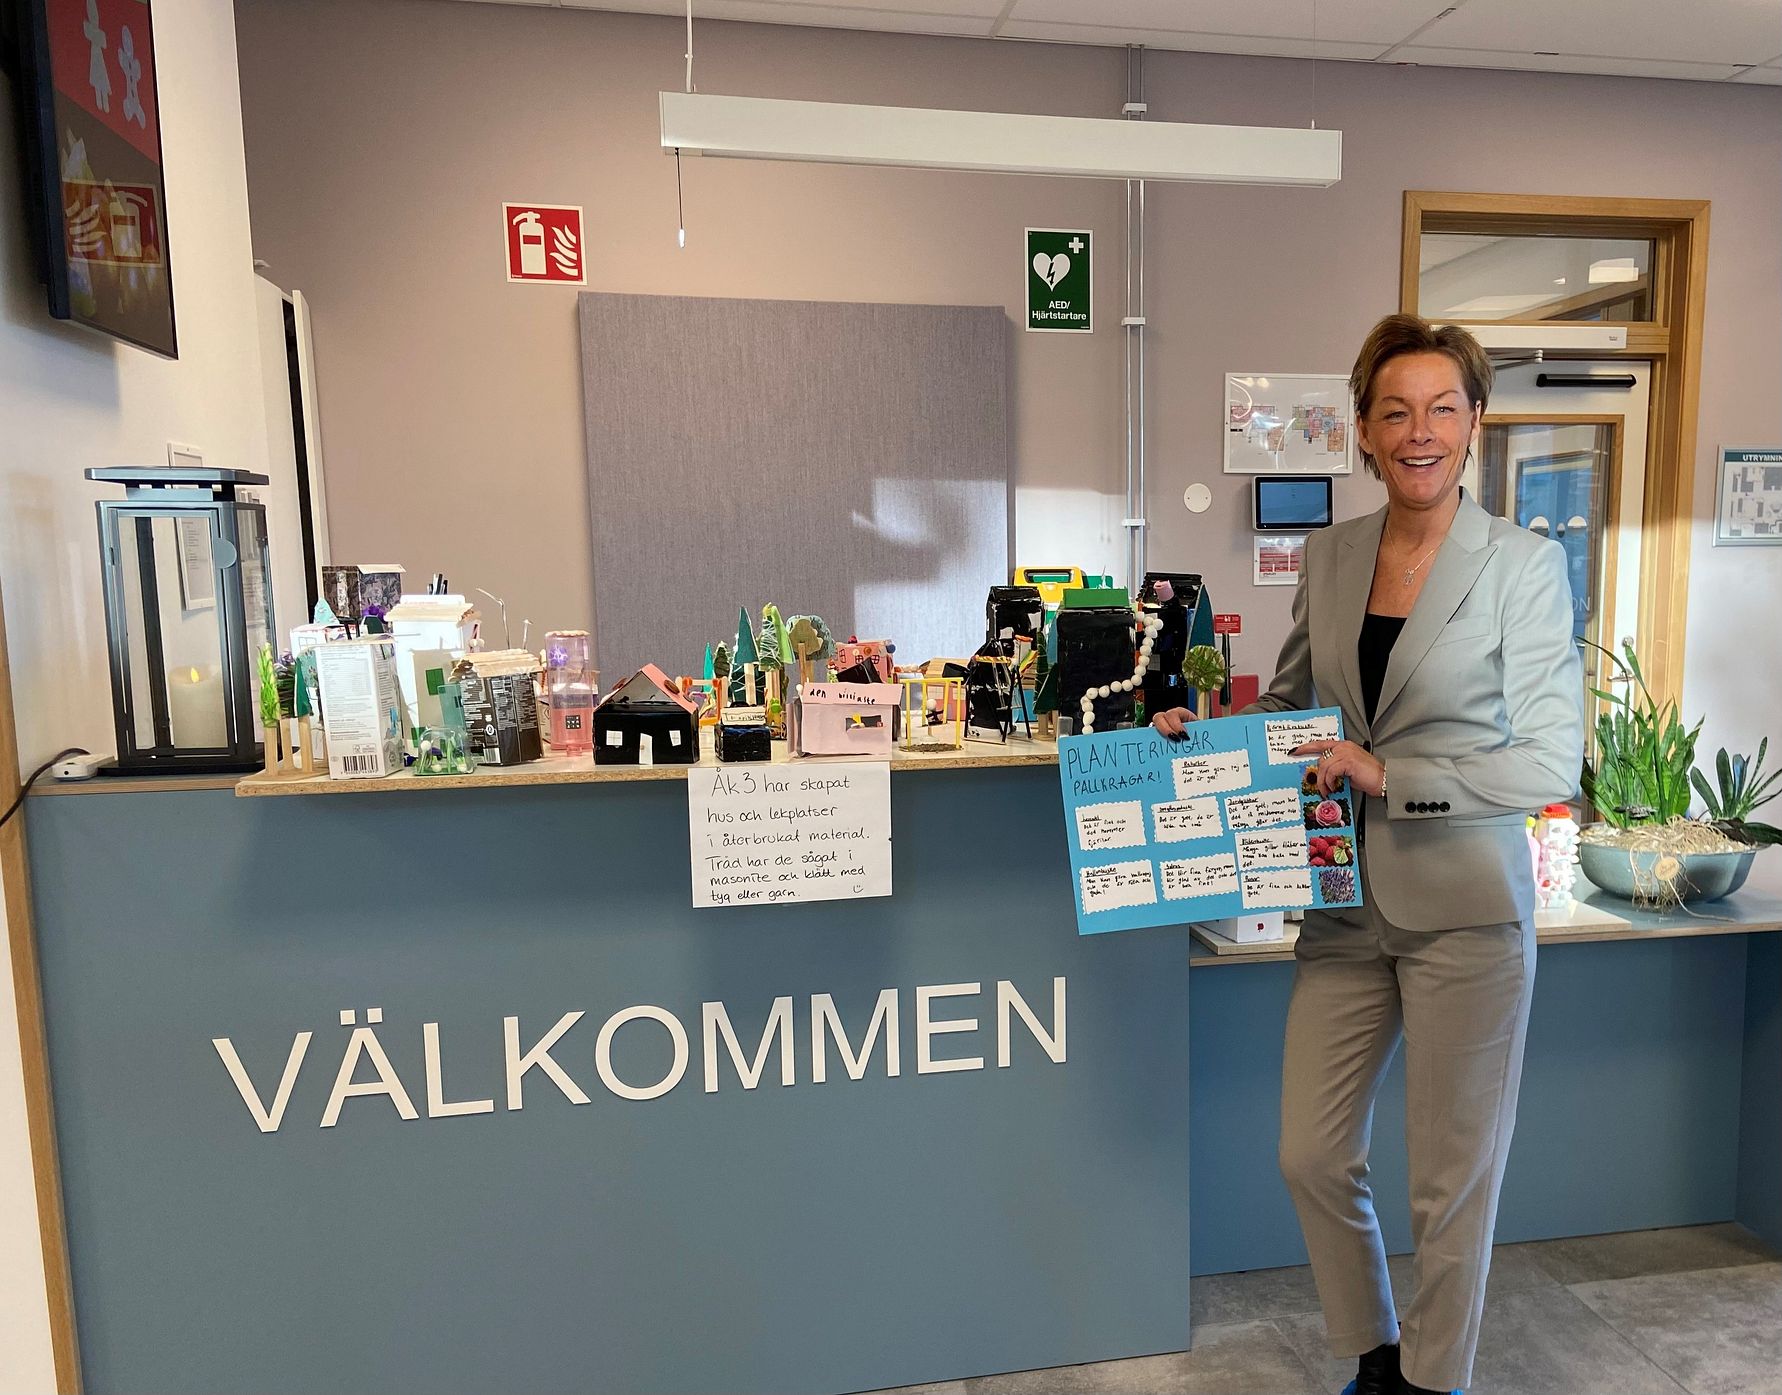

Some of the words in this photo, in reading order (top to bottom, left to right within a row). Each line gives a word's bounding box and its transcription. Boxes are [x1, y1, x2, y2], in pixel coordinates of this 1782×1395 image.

[1032, 310, 1087, 321] Hjärtstartare
[1048, 300, 1071, 310] AED/
[1066, 730, 1215, 780] PLANTERINGAR
[711, 766, 741, 797] Åk
[742, 771, 757, 794] 3
[763, 773, 791, 793] har
[800, 775, 851, 796] skapat
[1073, 770, 1162, 797] PALLKRAGAR!
[707, 807, 734, 824] hus
[739, 808, 762, 822] och
[769, 805, 839, 825] lekplatser
[706, 833, 714, 848] i
[722, 828, 800, 847] återbrukat
[808, 826, 871, 842] material.
[746, 852, 770, 867] har
[774, 853, 794, 866] de
[801, 850, 838, 868] sågat
[847, 849, 853, 861] i
[709, 872, 772, 888] masonite
[778, 869, 800, 882] och
[840, 866, 866, 877] med
[737, 889, 764, 900] eller
[768, 889, 801, 902] garn.
[212, 975, 1070, 1134] VÄLKOMMEN
